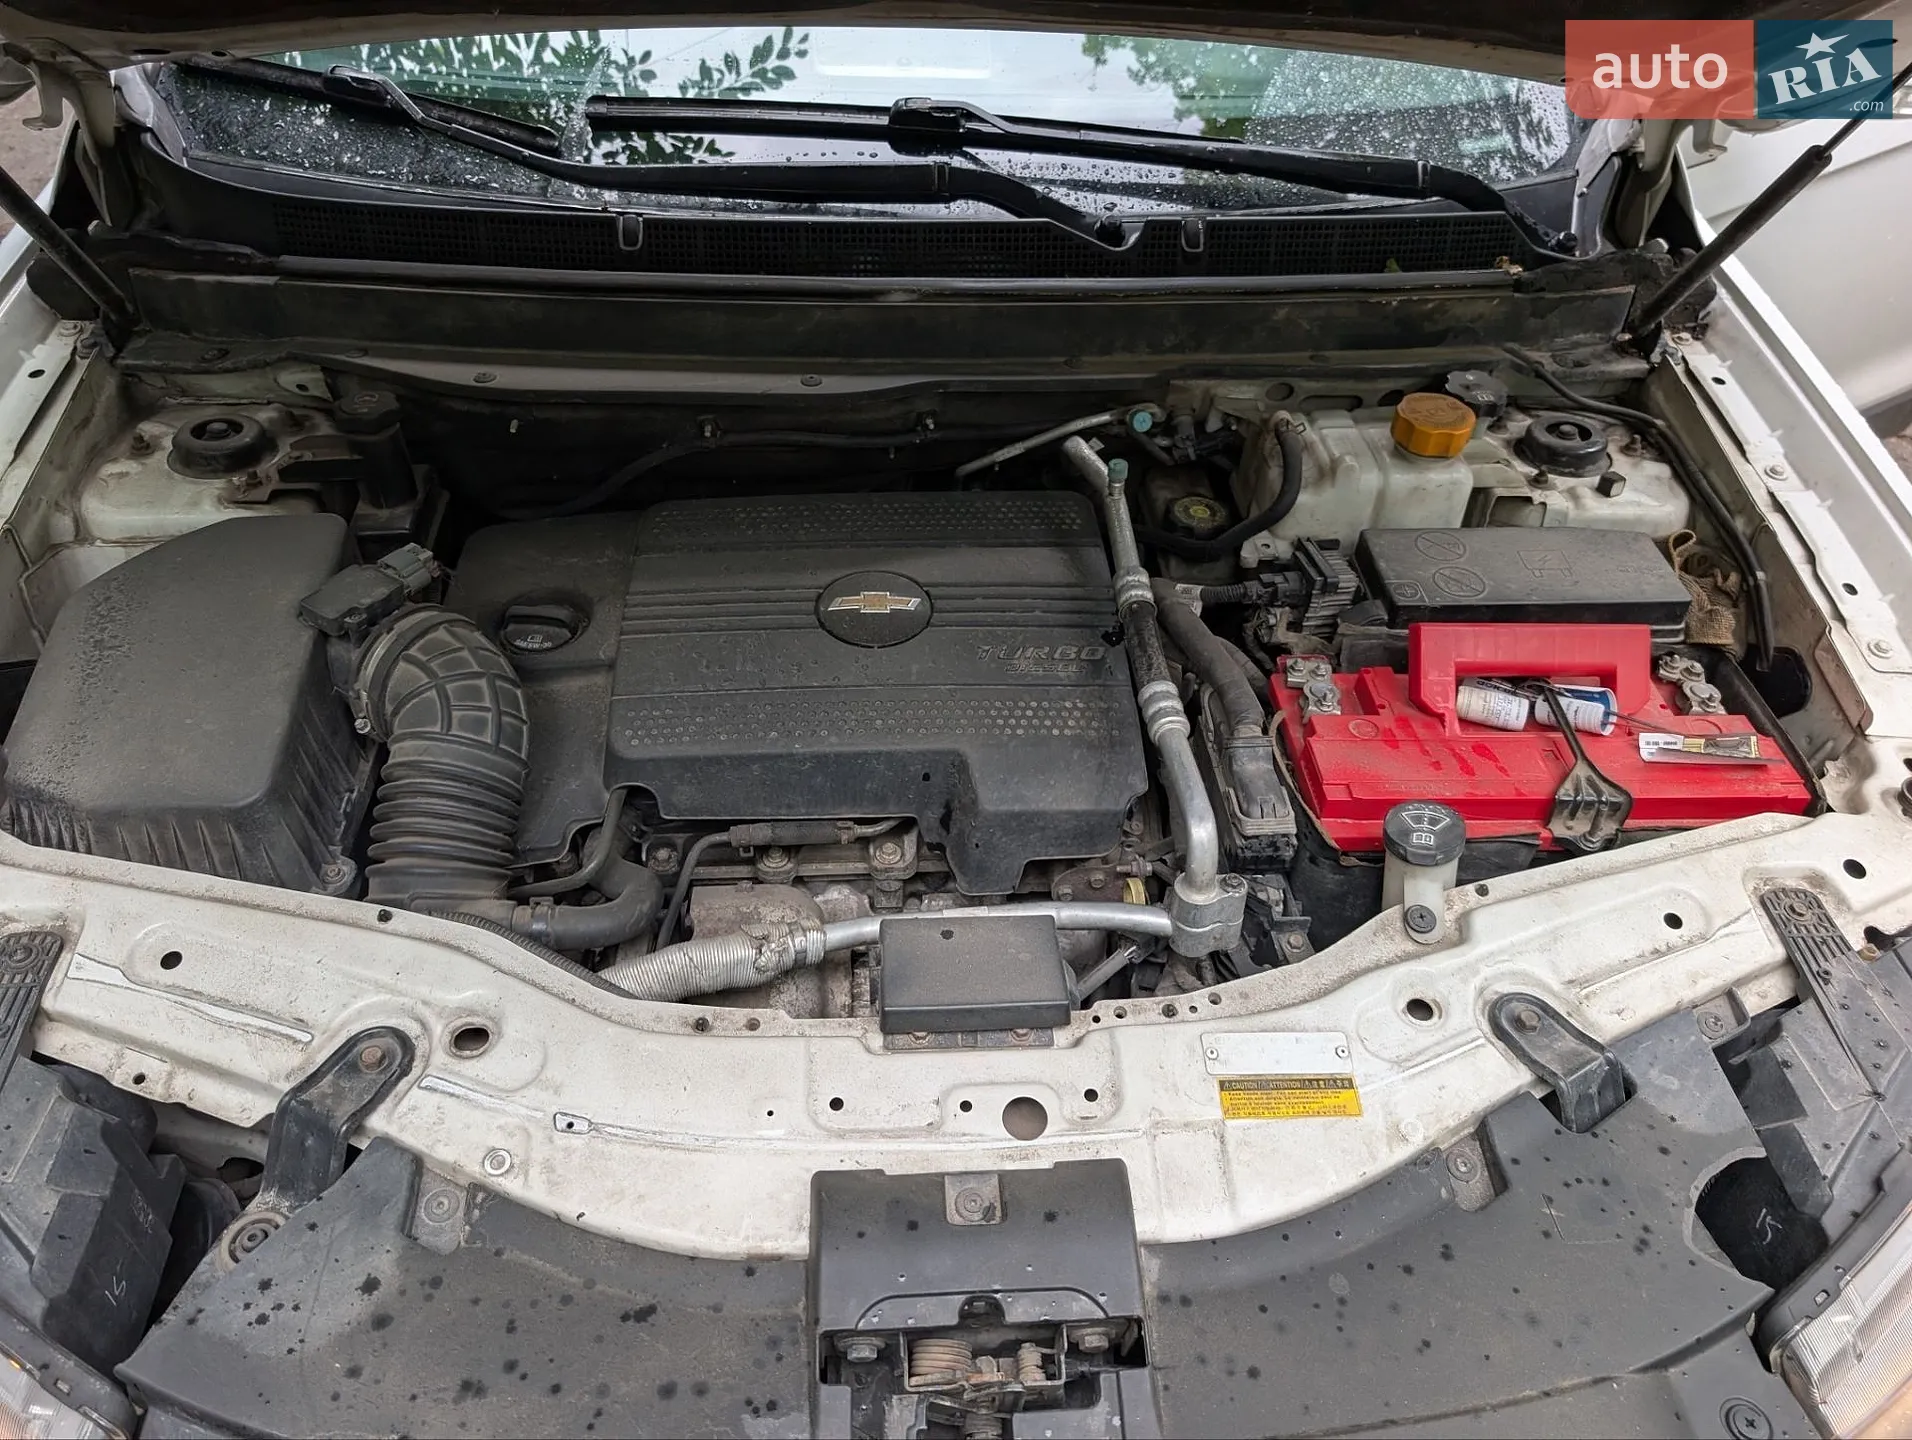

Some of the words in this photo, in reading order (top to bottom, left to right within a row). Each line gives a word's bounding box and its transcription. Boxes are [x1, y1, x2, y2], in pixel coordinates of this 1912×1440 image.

[977, 645, 1106, 661] TURBO
[1004, 661, 1084, 674] DIESEL
[1232, 1082, 1258, 1090] CAUTION
[1269, 1081, 1301, 1089] ATTENTION
